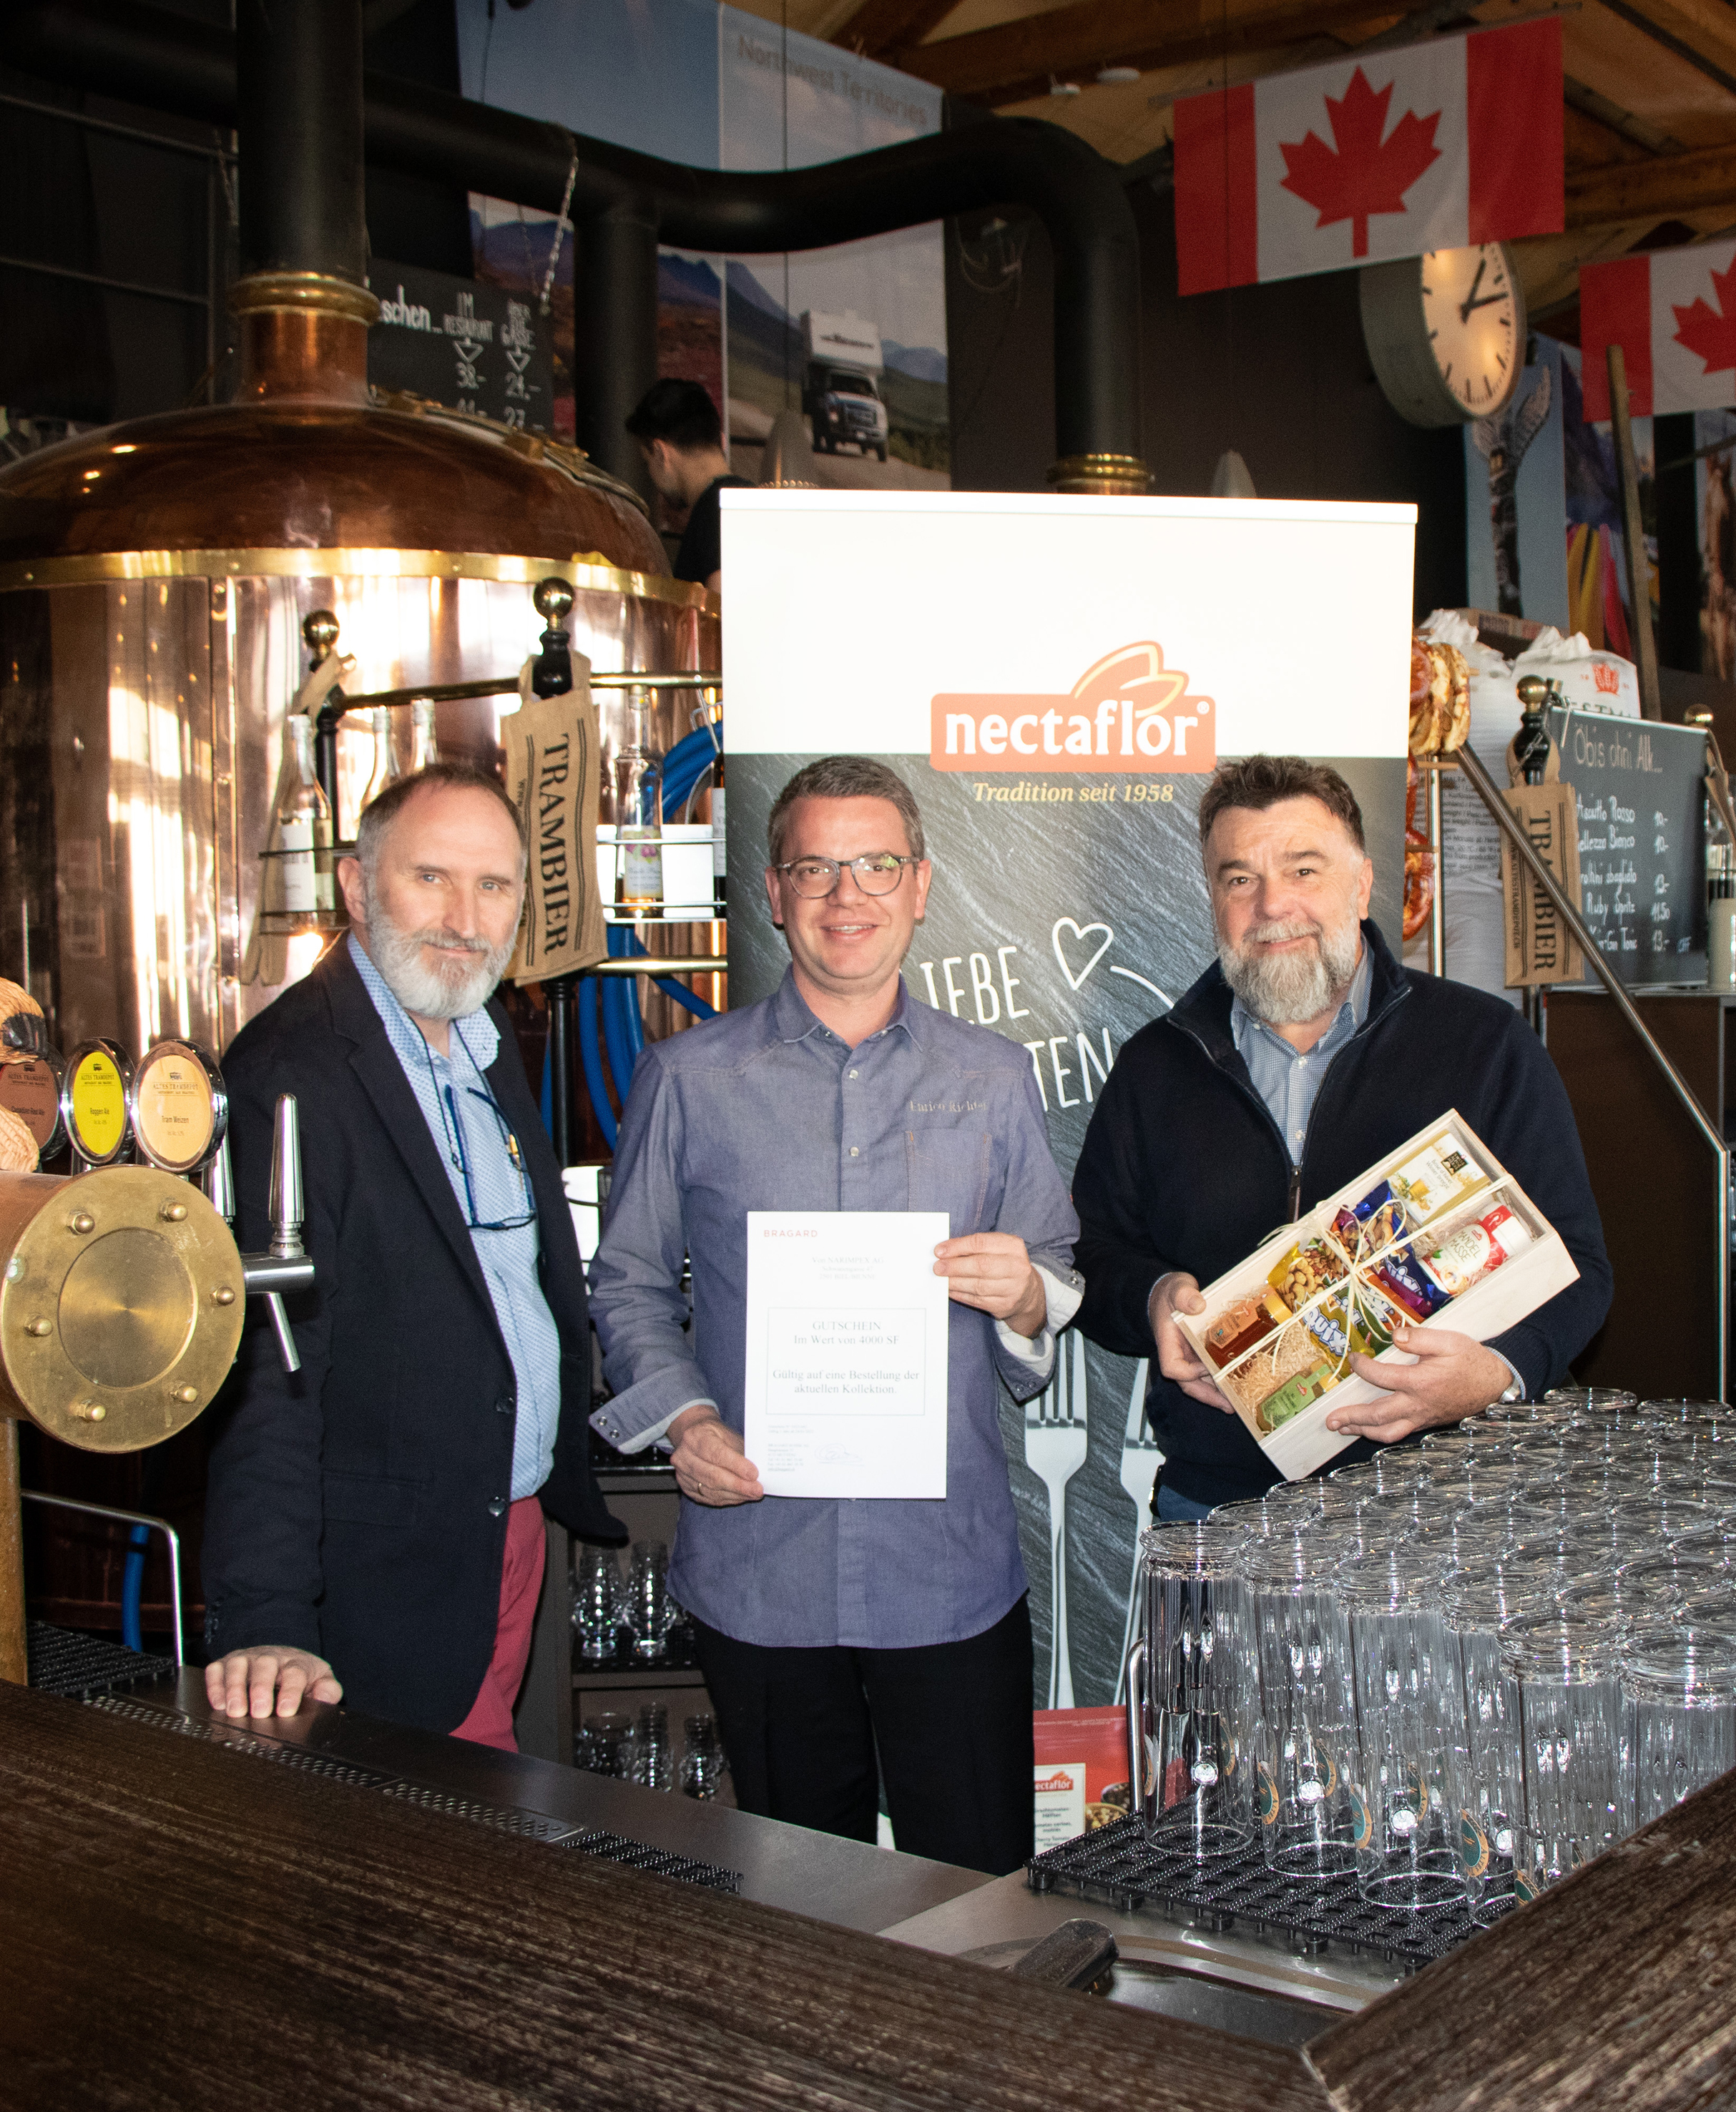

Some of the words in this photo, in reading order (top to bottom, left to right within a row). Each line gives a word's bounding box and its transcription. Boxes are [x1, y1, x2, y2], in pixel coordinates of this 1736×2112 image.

[945, 699, 1198, 756] nectaflor
[974, 782, 1074, 802] Tradition
[1079, 782, 1117, 802] seit
[1122, 783, 1175, 802] 1958
[539, 732, 570, 955] TRAMBIER
[1578, 829, 1607, 853] ellezza
[1586, 892, 1609, 925] Ruby
[920, 946, 1030, 1025] IEBE
[1024, 1027, 1114, 1111] TEN
[764, 1229, 818, 1238] BRAGARD
[1458, 1230, 1481, 1259] MANDEL
[1448, 1238, 1471, 1262] MASSE
[813, 1321, 882, 1331] GUTSCHEIN
[794, 1335, 808, 1345] Im
[810, 1335, 835, 1345] Wert
[838, 1336, 856, 1345] von
[858, 1335, 884, 1345] 4000
[886, 1335, 900, 1345] SF
[773, 1369, 804, 1381] Gültig
[807, 1369, 823, 1380] auf
[825, 1370, 846, 1380] eine
[849, 1370, 901, 1382] Bestellung
[903, 1370, 921, 1380] der
[794, 1384, 840, 1394] aktuellen
[842, 1384, 897, 1394] Kollektion.
